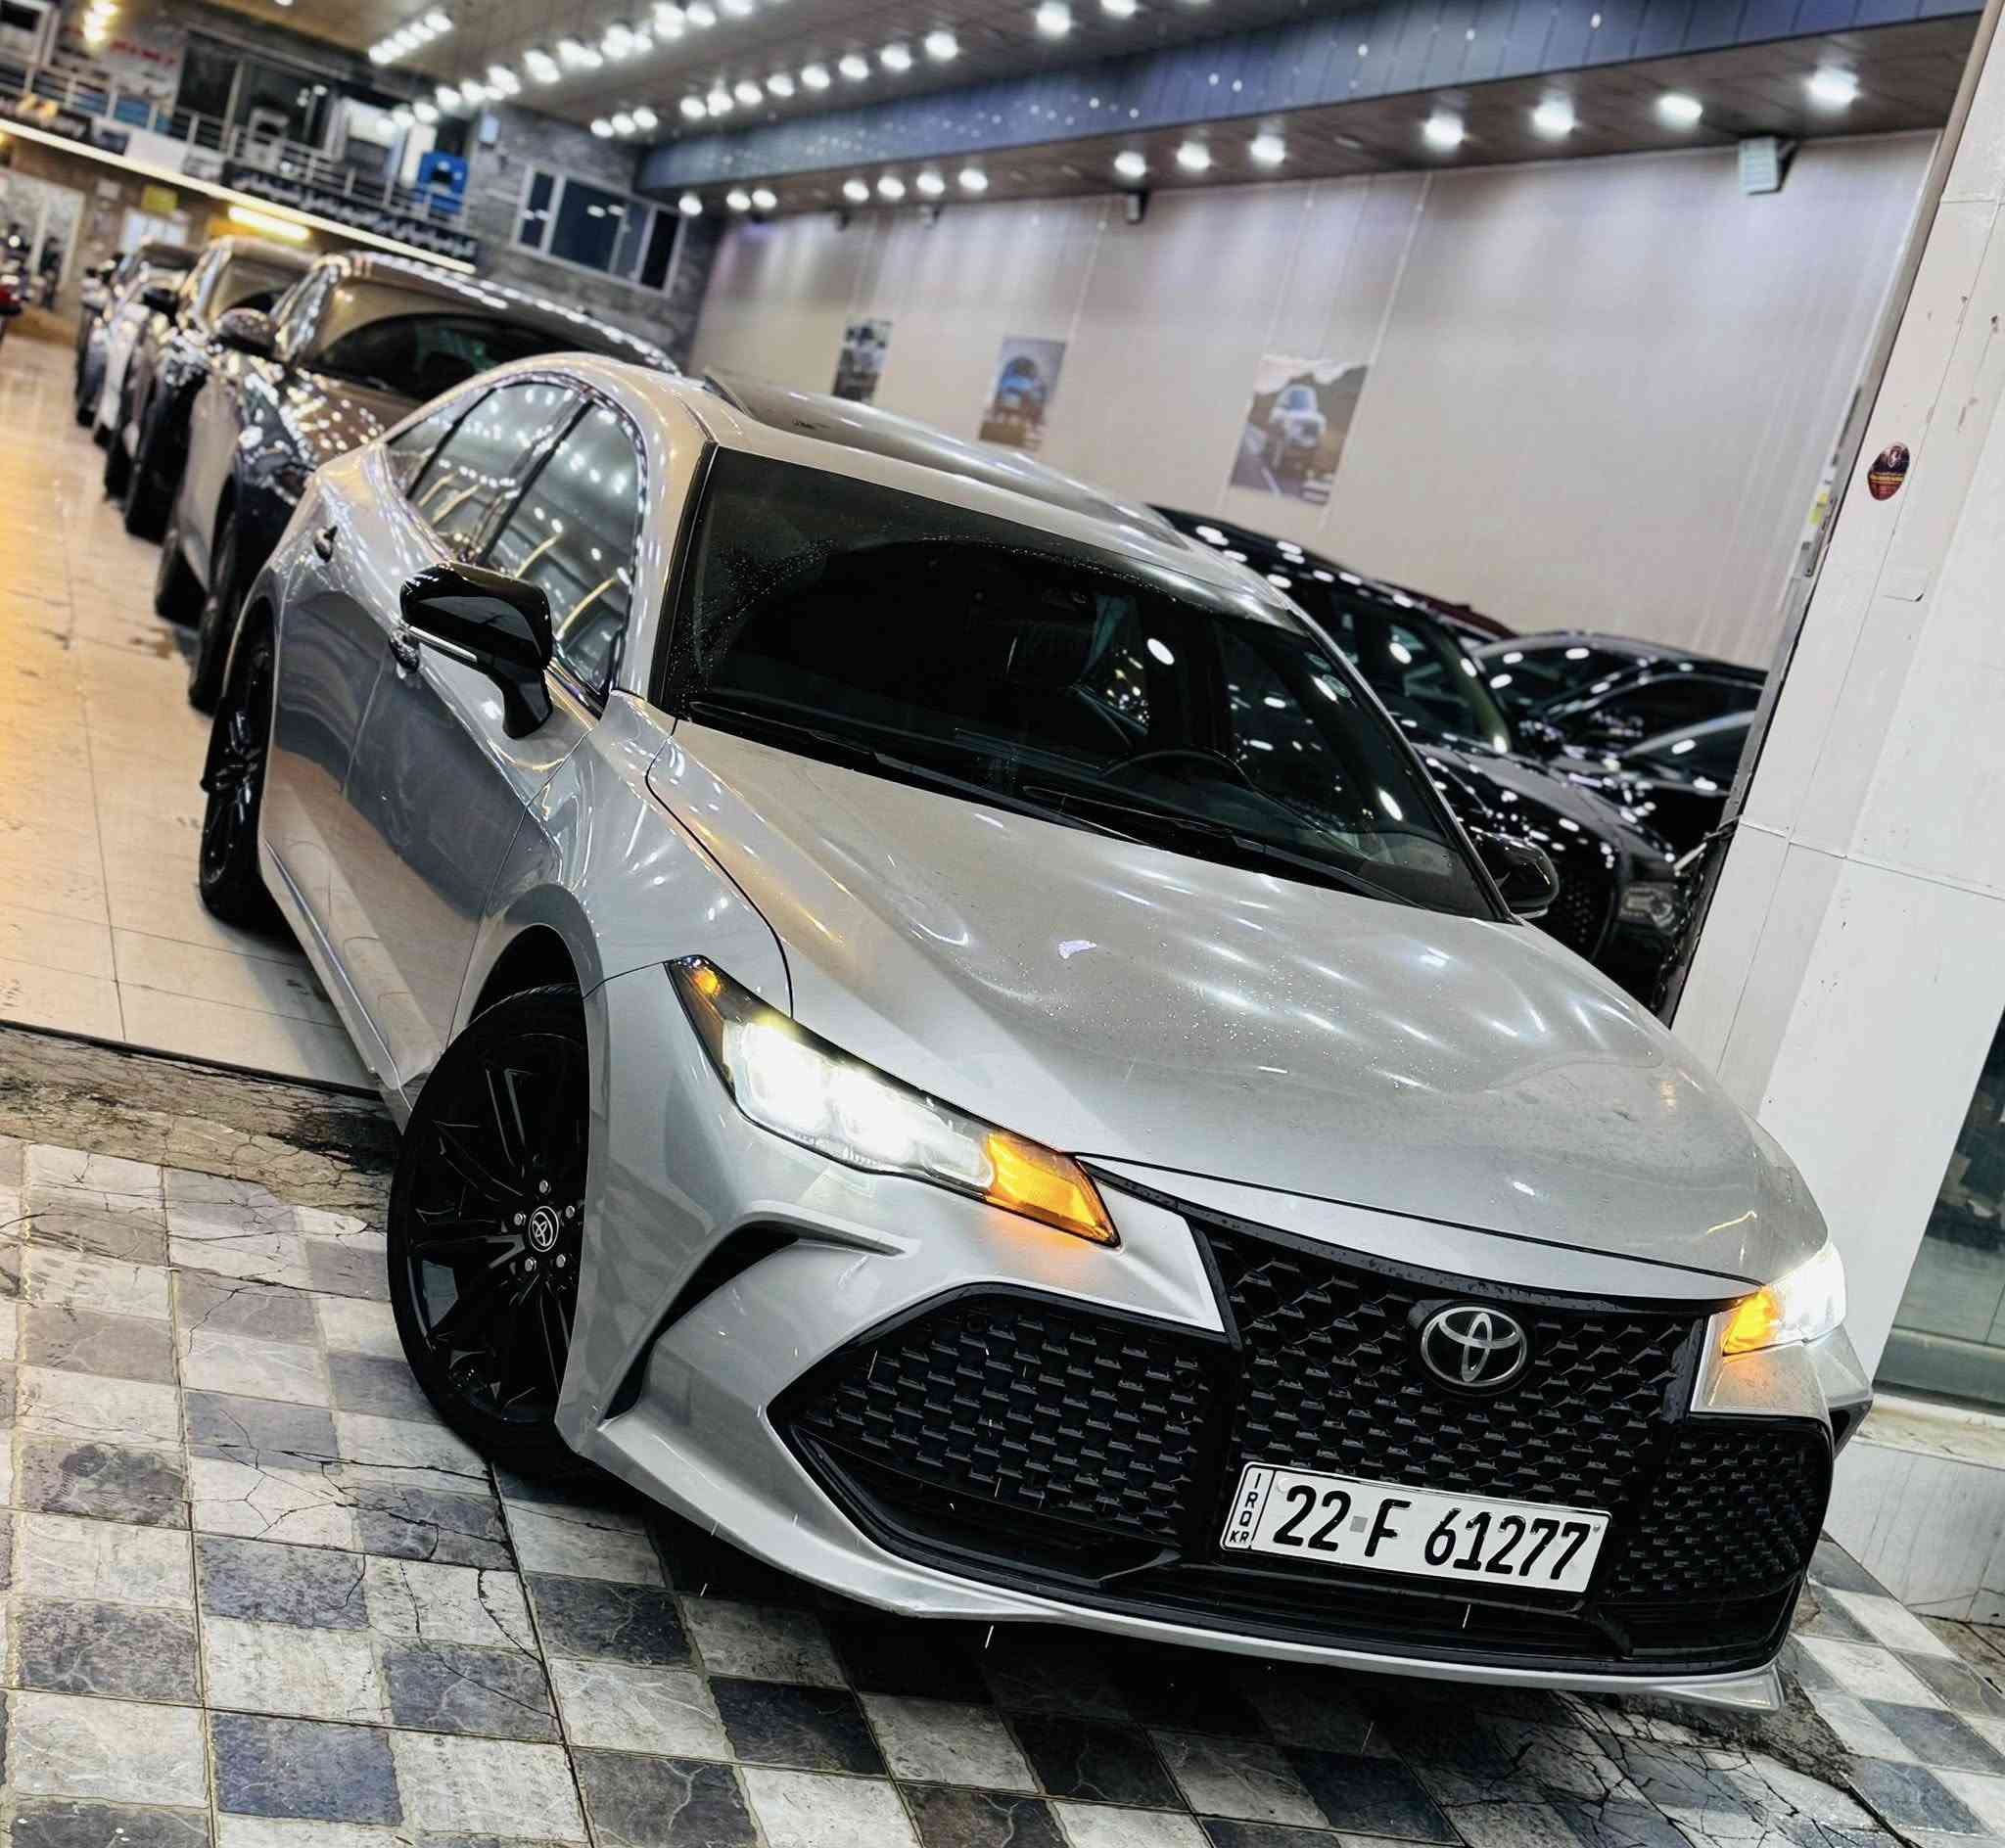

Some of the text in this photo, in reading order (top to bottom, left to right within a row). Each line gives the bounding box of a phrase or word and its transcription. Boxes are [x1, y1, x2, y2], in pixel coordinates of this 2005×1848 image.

[1238, 1472, 1262, 1527] IRQ
[1229, 1530, 1250, 1543] KR
[1273, 1484, 1591, 1580] 22 F 61277
